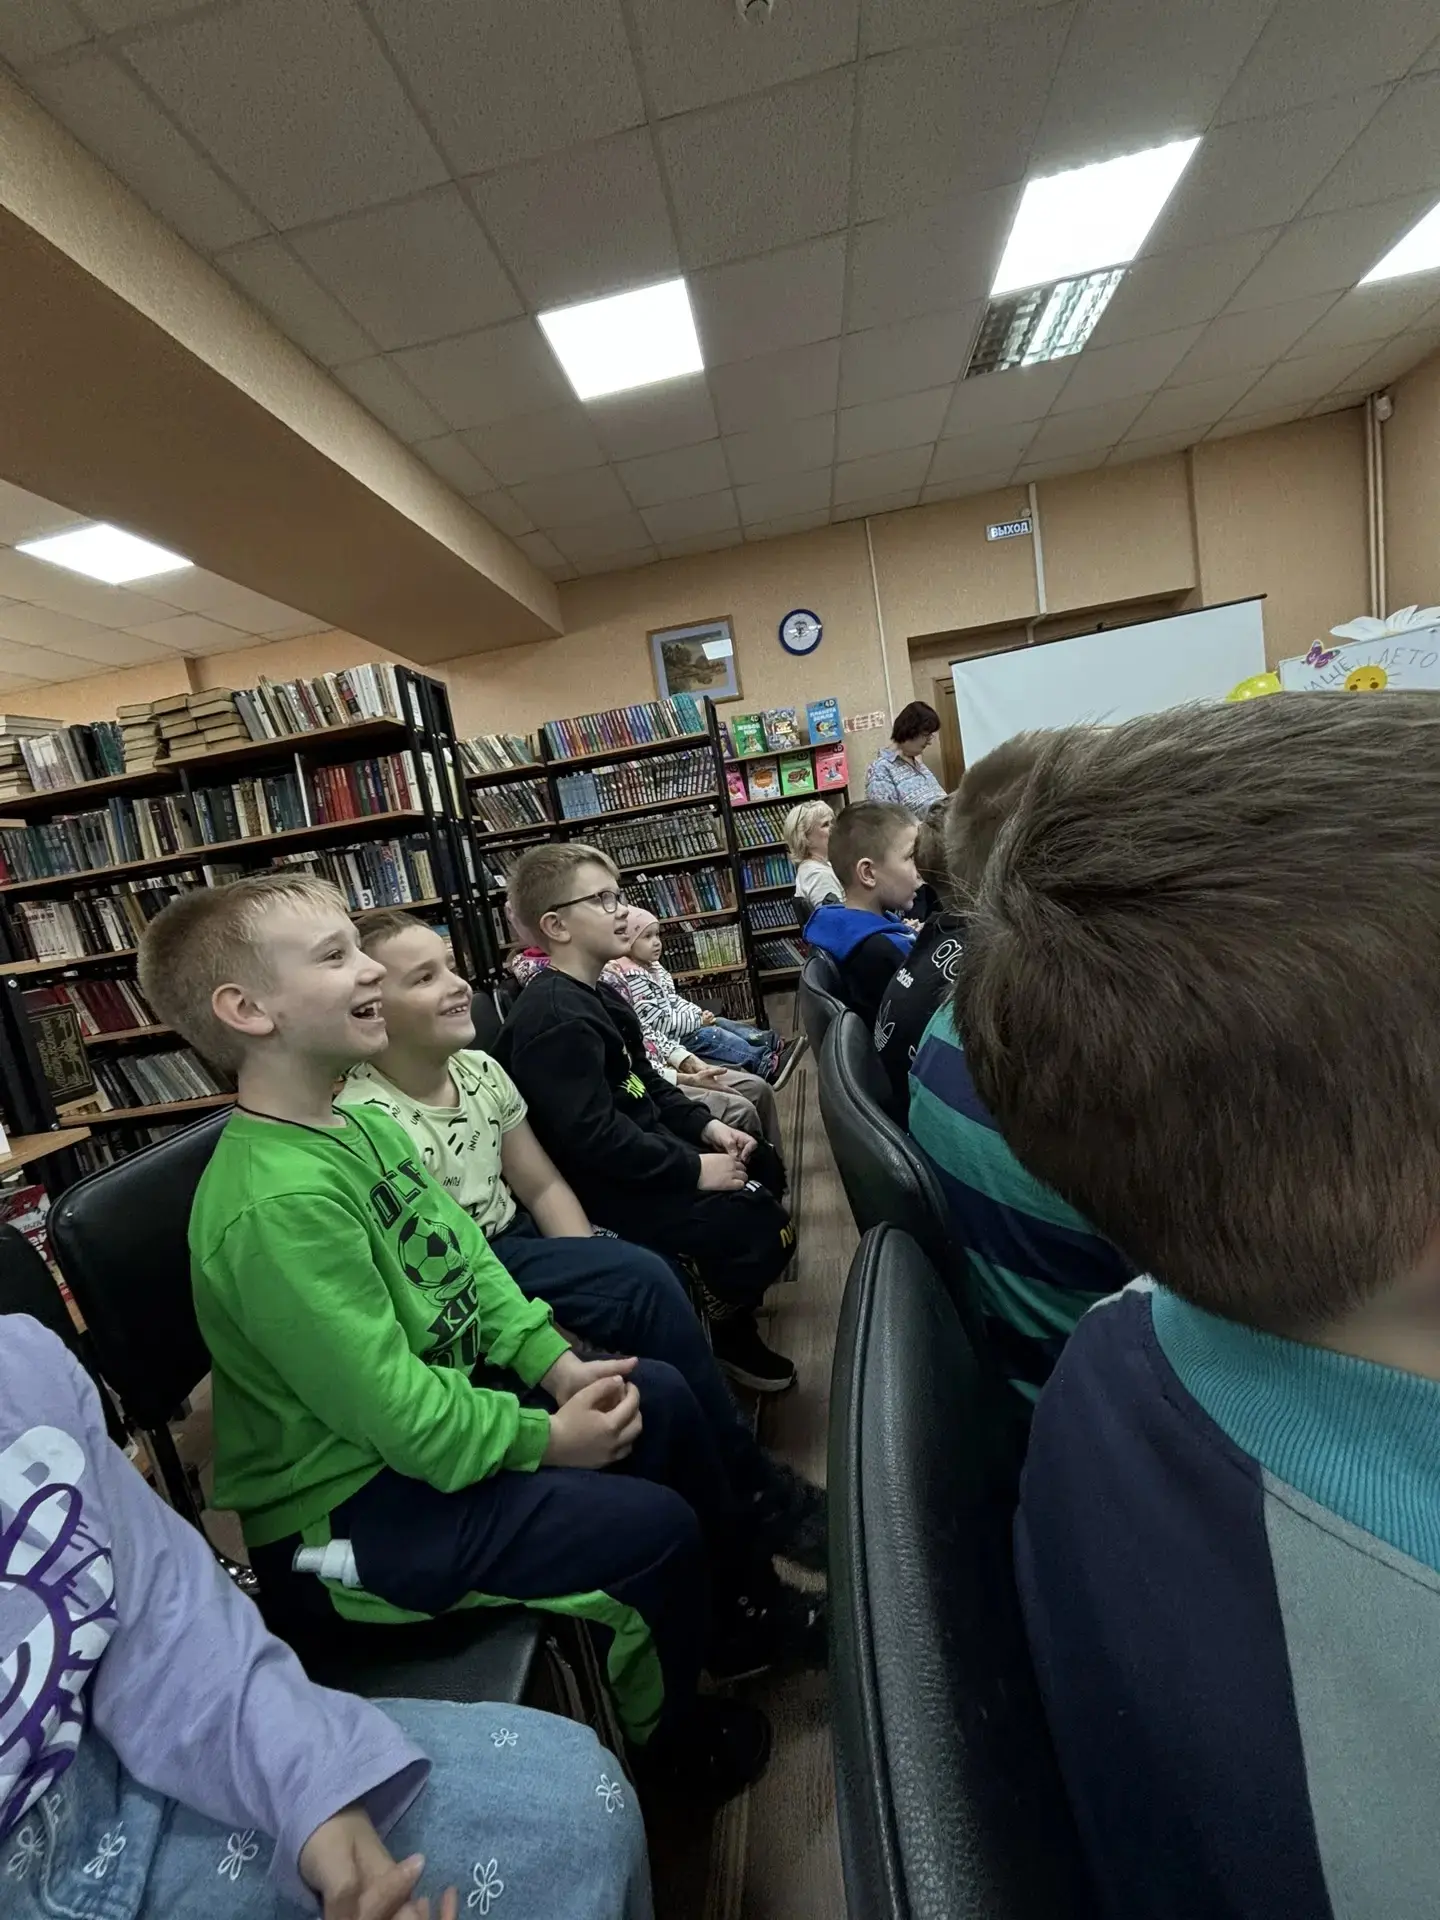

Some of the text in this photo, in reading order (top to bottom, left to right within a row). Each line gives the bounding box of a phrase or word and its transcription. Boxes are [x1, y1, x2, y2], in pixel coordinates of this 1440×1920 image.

[990, 521, 1029, 538] ВЫХОД
[1375, 647, 1439, 669] ЛЕТО
[467, 1130, 480, 1151] FUN!
